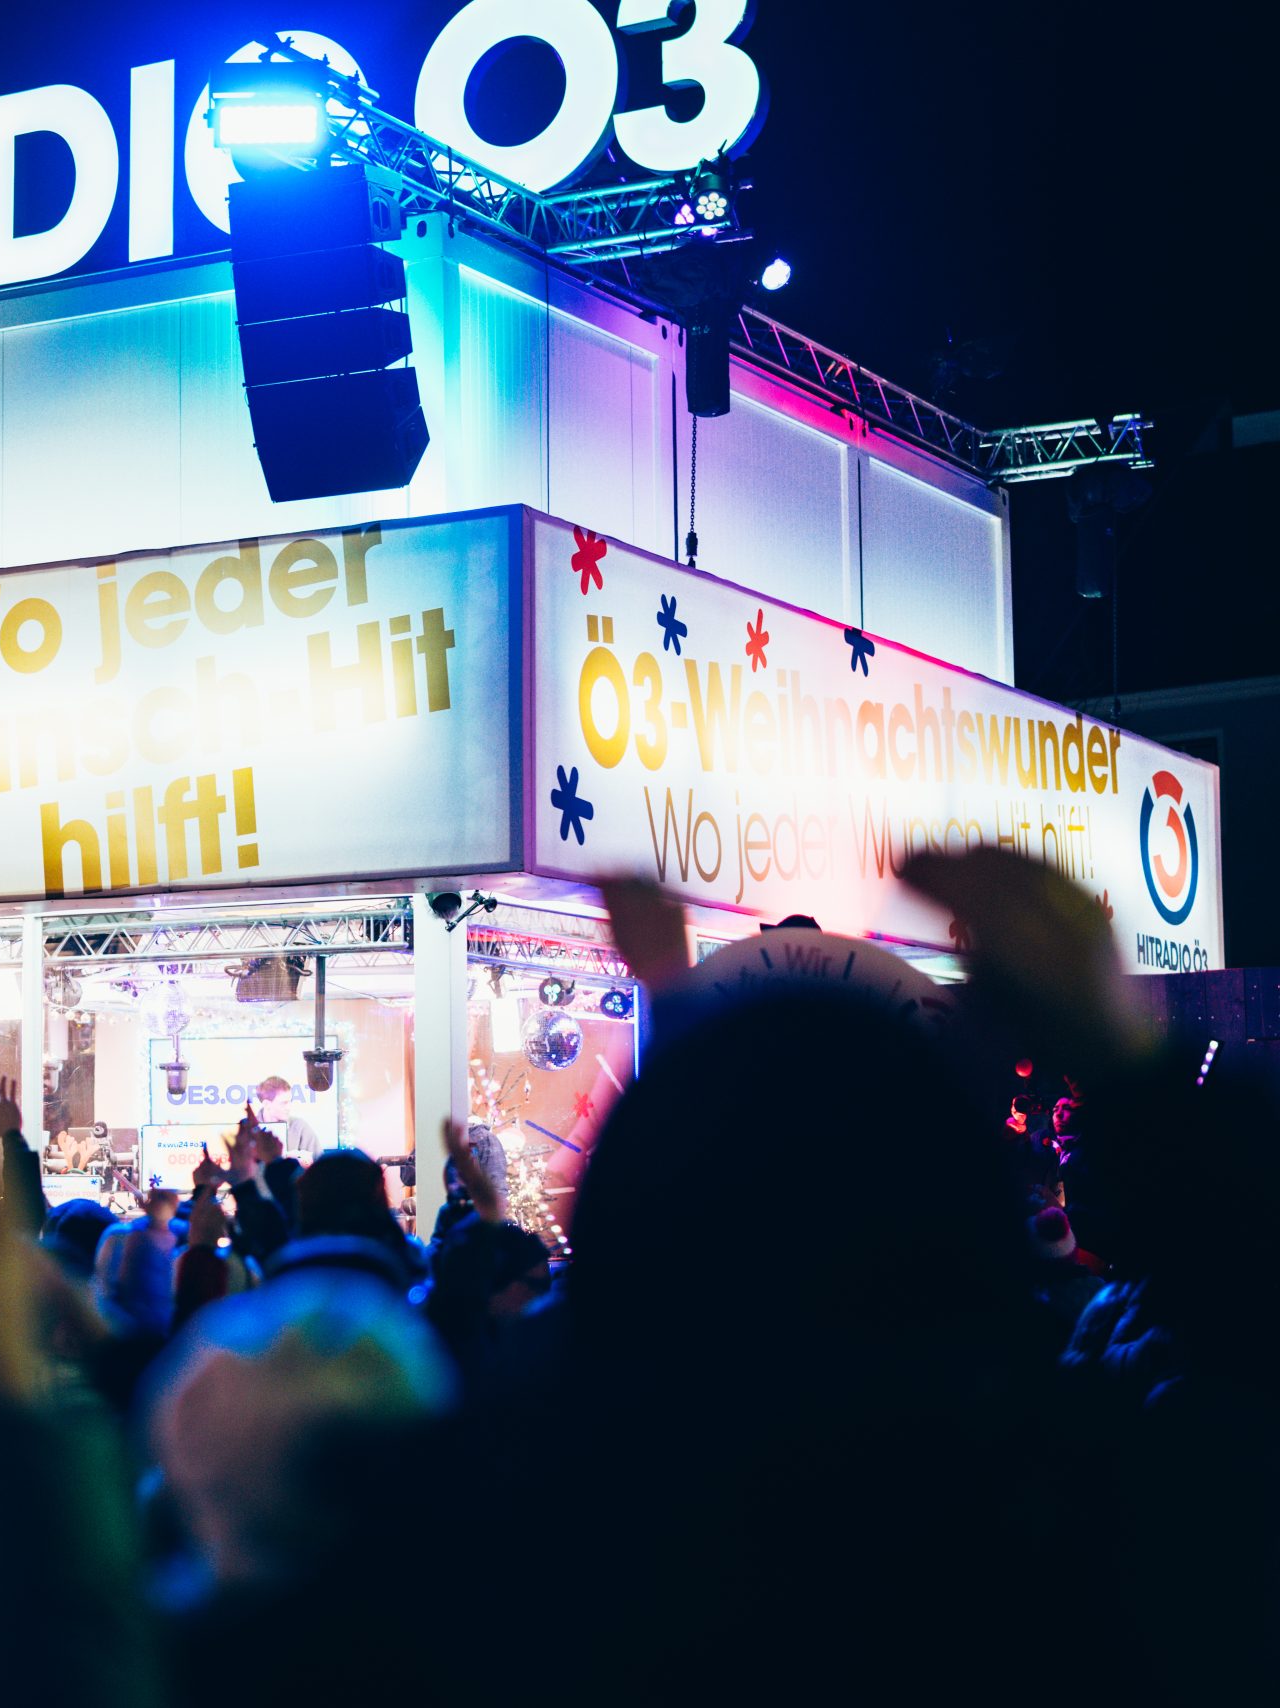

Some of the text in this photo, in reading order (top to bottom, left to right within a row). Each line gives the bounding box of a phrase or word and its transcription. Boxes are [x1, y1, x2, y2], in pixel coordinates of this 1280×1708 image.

[93, 522, 383, 685] jeder
[578, 614, 1121, 795] Ö3-Weihnachtswunder
[40, 767, 260, 898] hilft!
[644, 787, 723, 883] Wo
[735, 787, 839, 904] jeder
[1040, 803, 1094, 880] hilft!
[1136, 932, 1209, 974] HITRADIO Ö3
